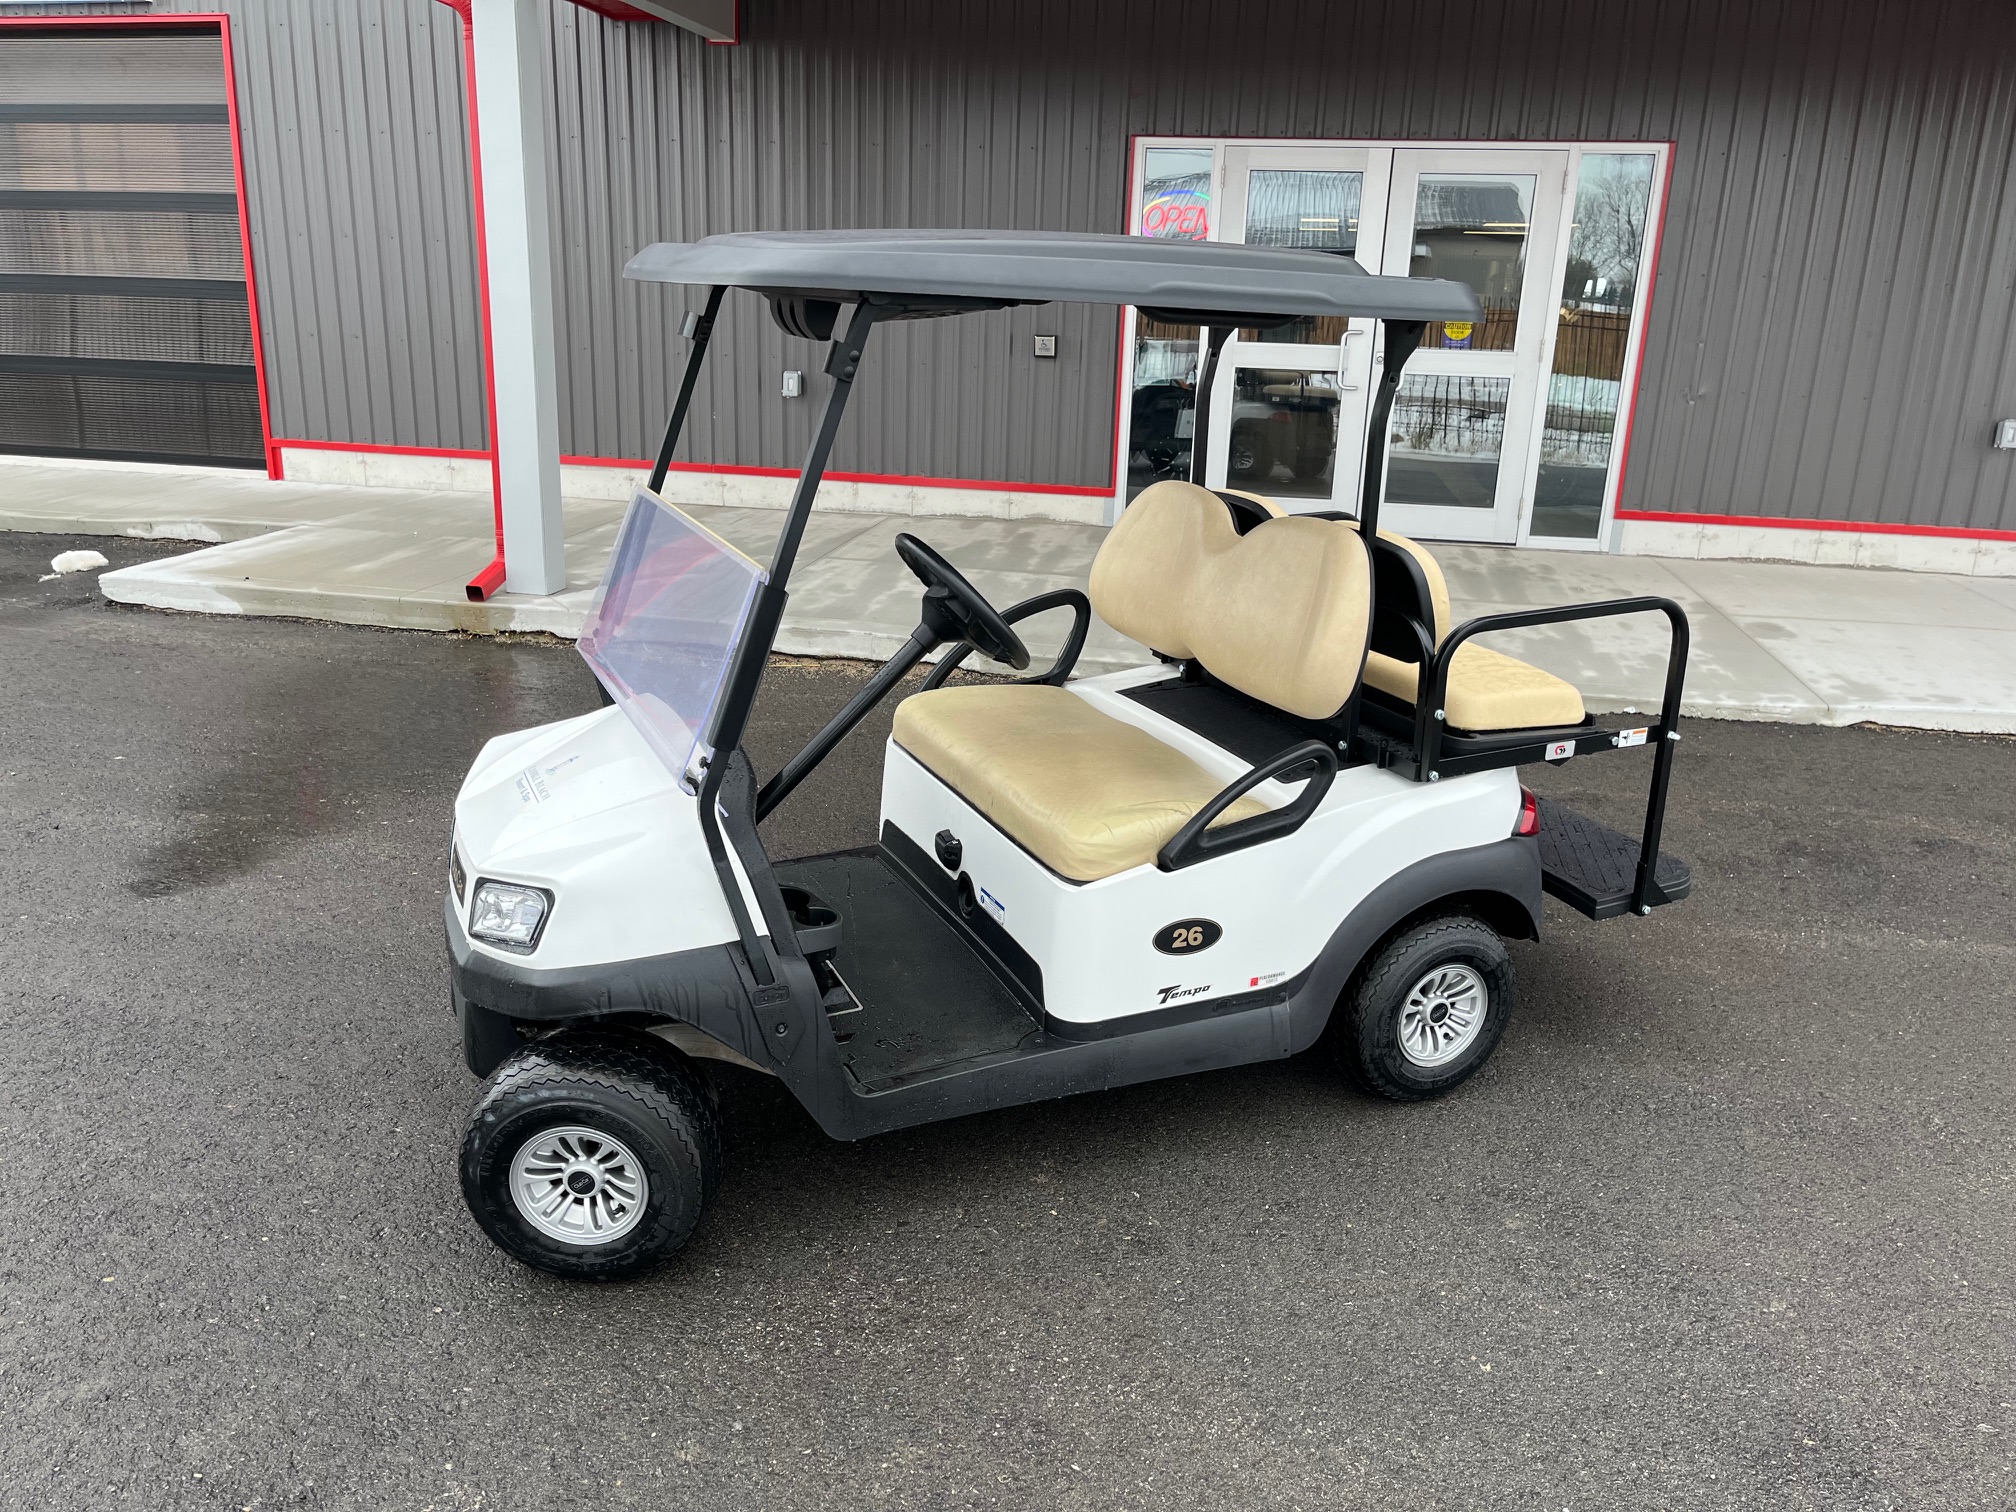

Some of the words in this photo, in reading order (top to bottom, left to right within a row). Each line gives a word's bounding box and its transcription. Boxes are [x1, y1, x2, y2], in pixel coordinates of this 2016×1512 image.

[1144, 204, 1208, 233] OPEN
[1171, 926, 1203, 948] 26
[1157, 984, 1213, 1005] Tempo
